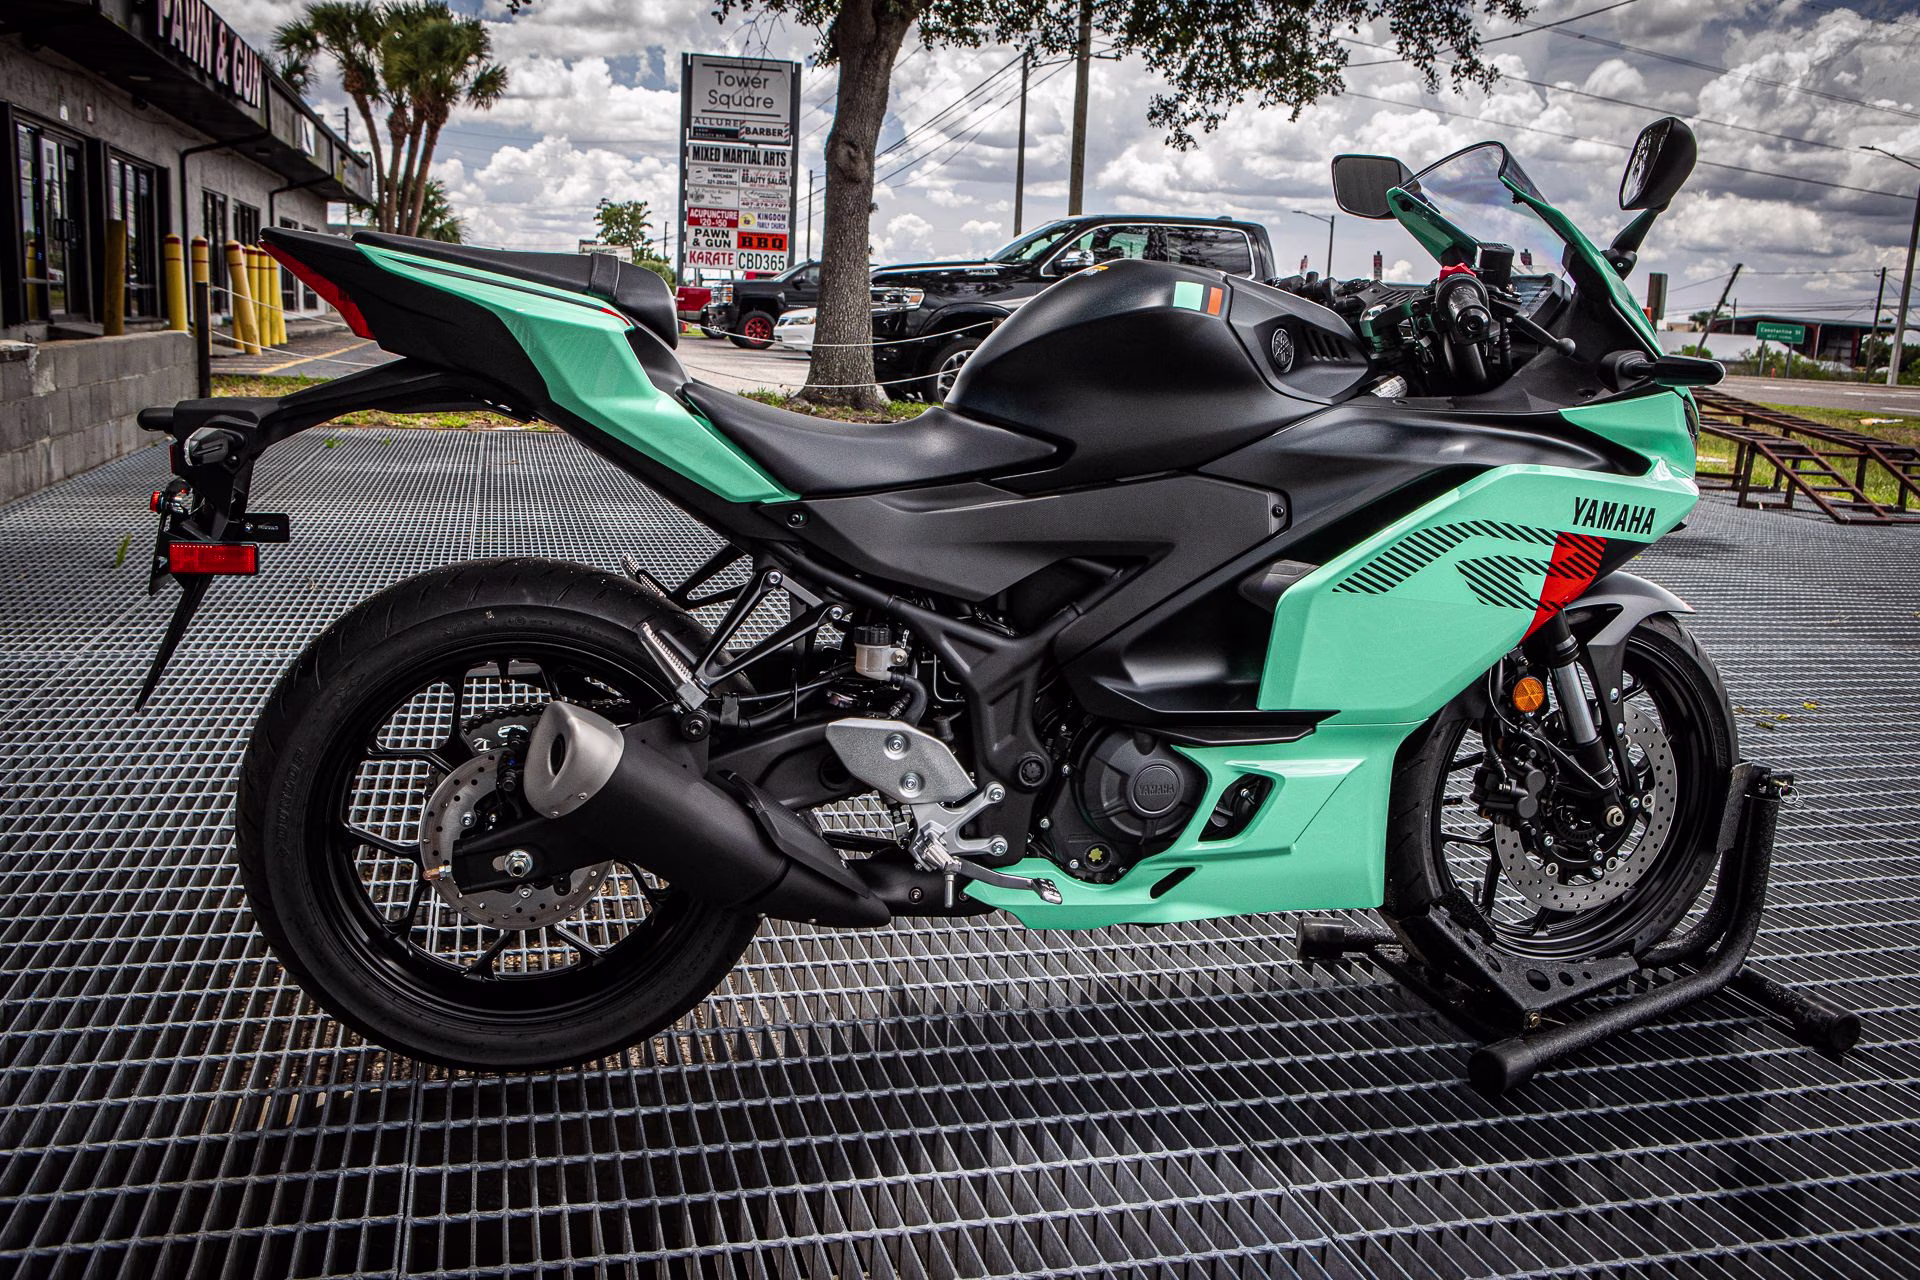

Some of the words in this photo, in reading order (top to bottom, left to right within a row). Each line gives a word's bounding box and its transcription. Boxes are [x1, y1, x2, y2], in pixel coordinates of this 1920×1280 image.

[216, 21, 228, 85] &
[232, 36, 262, 109] GUN
[715, 71, 769, 89] Tower
[708, 89, 774, 109] Square
[693, 117, 739, 128] ALLURE
[745, 127, 783, 137] BARBER
[692, 146, 721, 162] MIXED
[722, 148, 761, 165] MARTIAL
[763, 151, 787, 167] ARTS
[741, 176, 766, 184] BEAUTY
[767, 178, 788, 186] SALON
[689, 209, 738, 220] ACUPUNCTURE
[757, 213, 786, 221] KINGDOM
[757, 221, 770, 229] FAMILY
[771, 222, 786, 230] CHURCH
[695, 228, 729, 239] PAWN
[692, 238, 700, 247] &
[705, 238, 731, 248] GUN
[741, 236, 783, 249] BBQ
[689, 250, 734, 266] KARATE
[738, 252, 785, 271] CBD365
[1572, 496, 1656, 535] YAMAHA
[1139, 783, 1175, 796] YAMAHA
